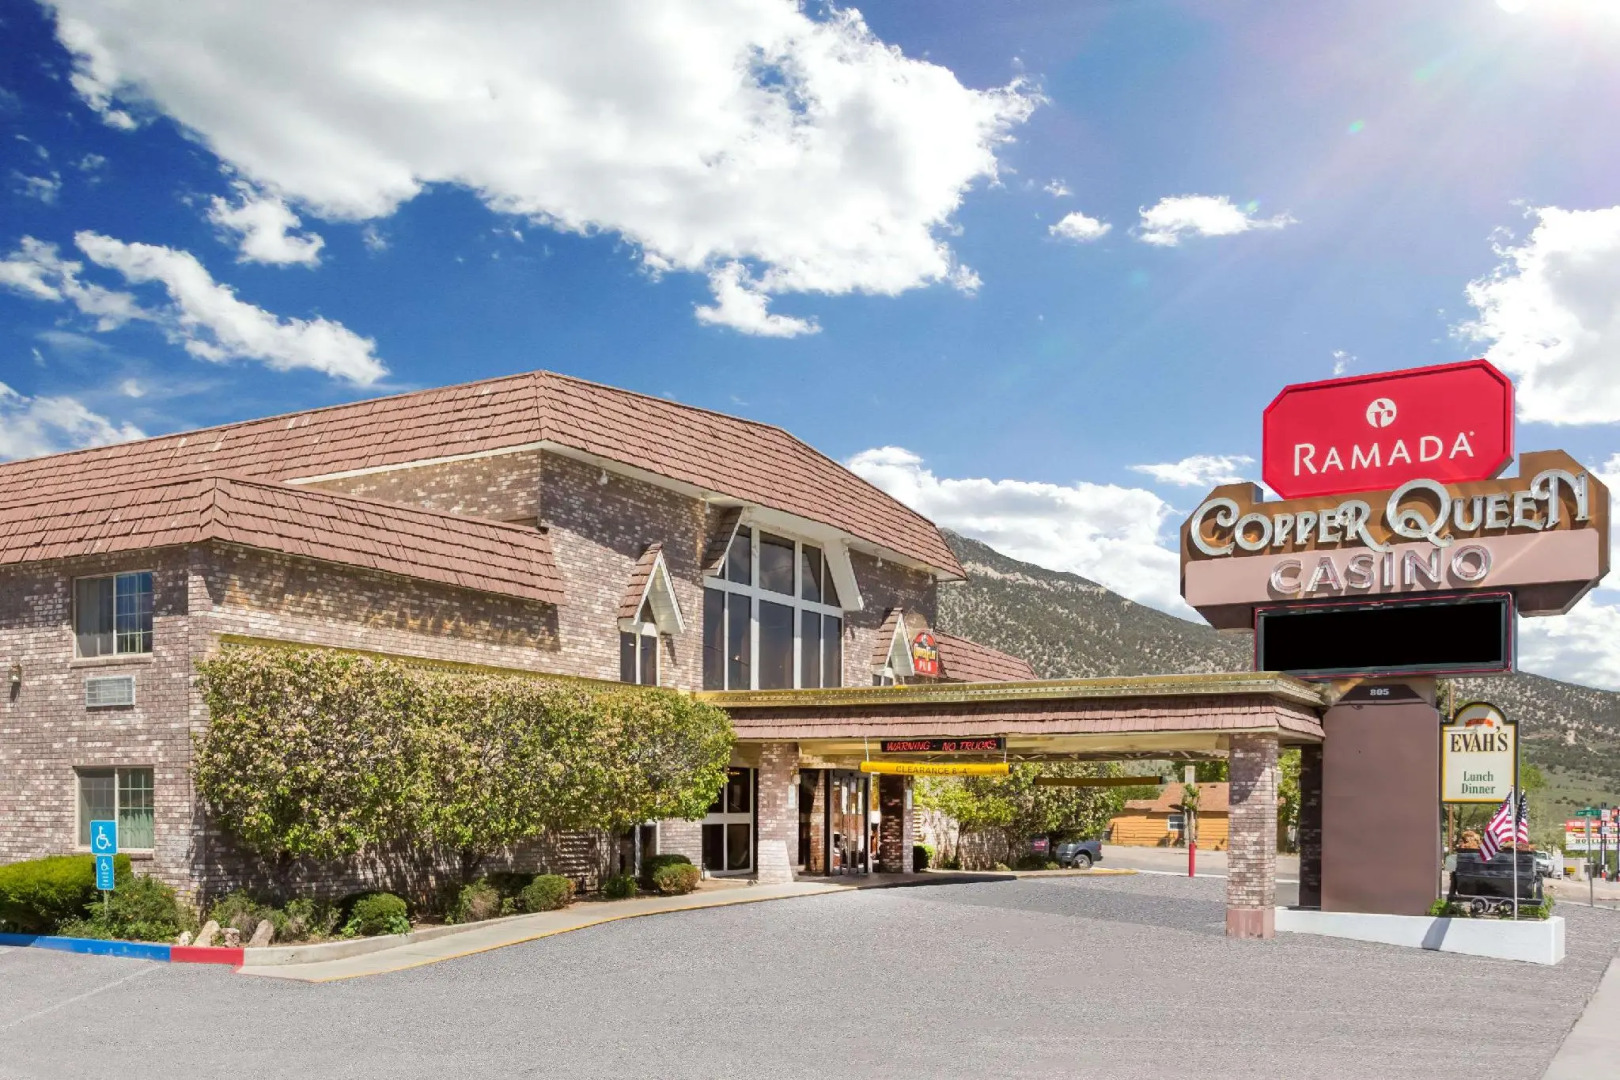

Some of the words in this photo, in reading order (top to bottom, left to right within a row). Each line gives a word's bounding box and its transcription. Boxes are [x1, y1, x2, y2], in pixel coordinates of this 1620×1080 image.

[1294, 432, 1474, 477] RAMADA
[1190, 496, 1391, 556] COPPER
[1387, 468, 1590, 548] QUEEN
[1270, 545, 1491, 594] CASINO
[1370, 688, 1390, 696] 805
[1450, 726, 1508, 753] EVAH'S
[886, 741, 931, 752] WARNING
[941, 741, 956, 752] NO
[959, 740, 997, 751] TRUCKS
[895, 765, 950, 775] CLEARANCE
[1463, 770, 1494, 782] Lunch
[1461, 783, 1496, 794] Dinner
